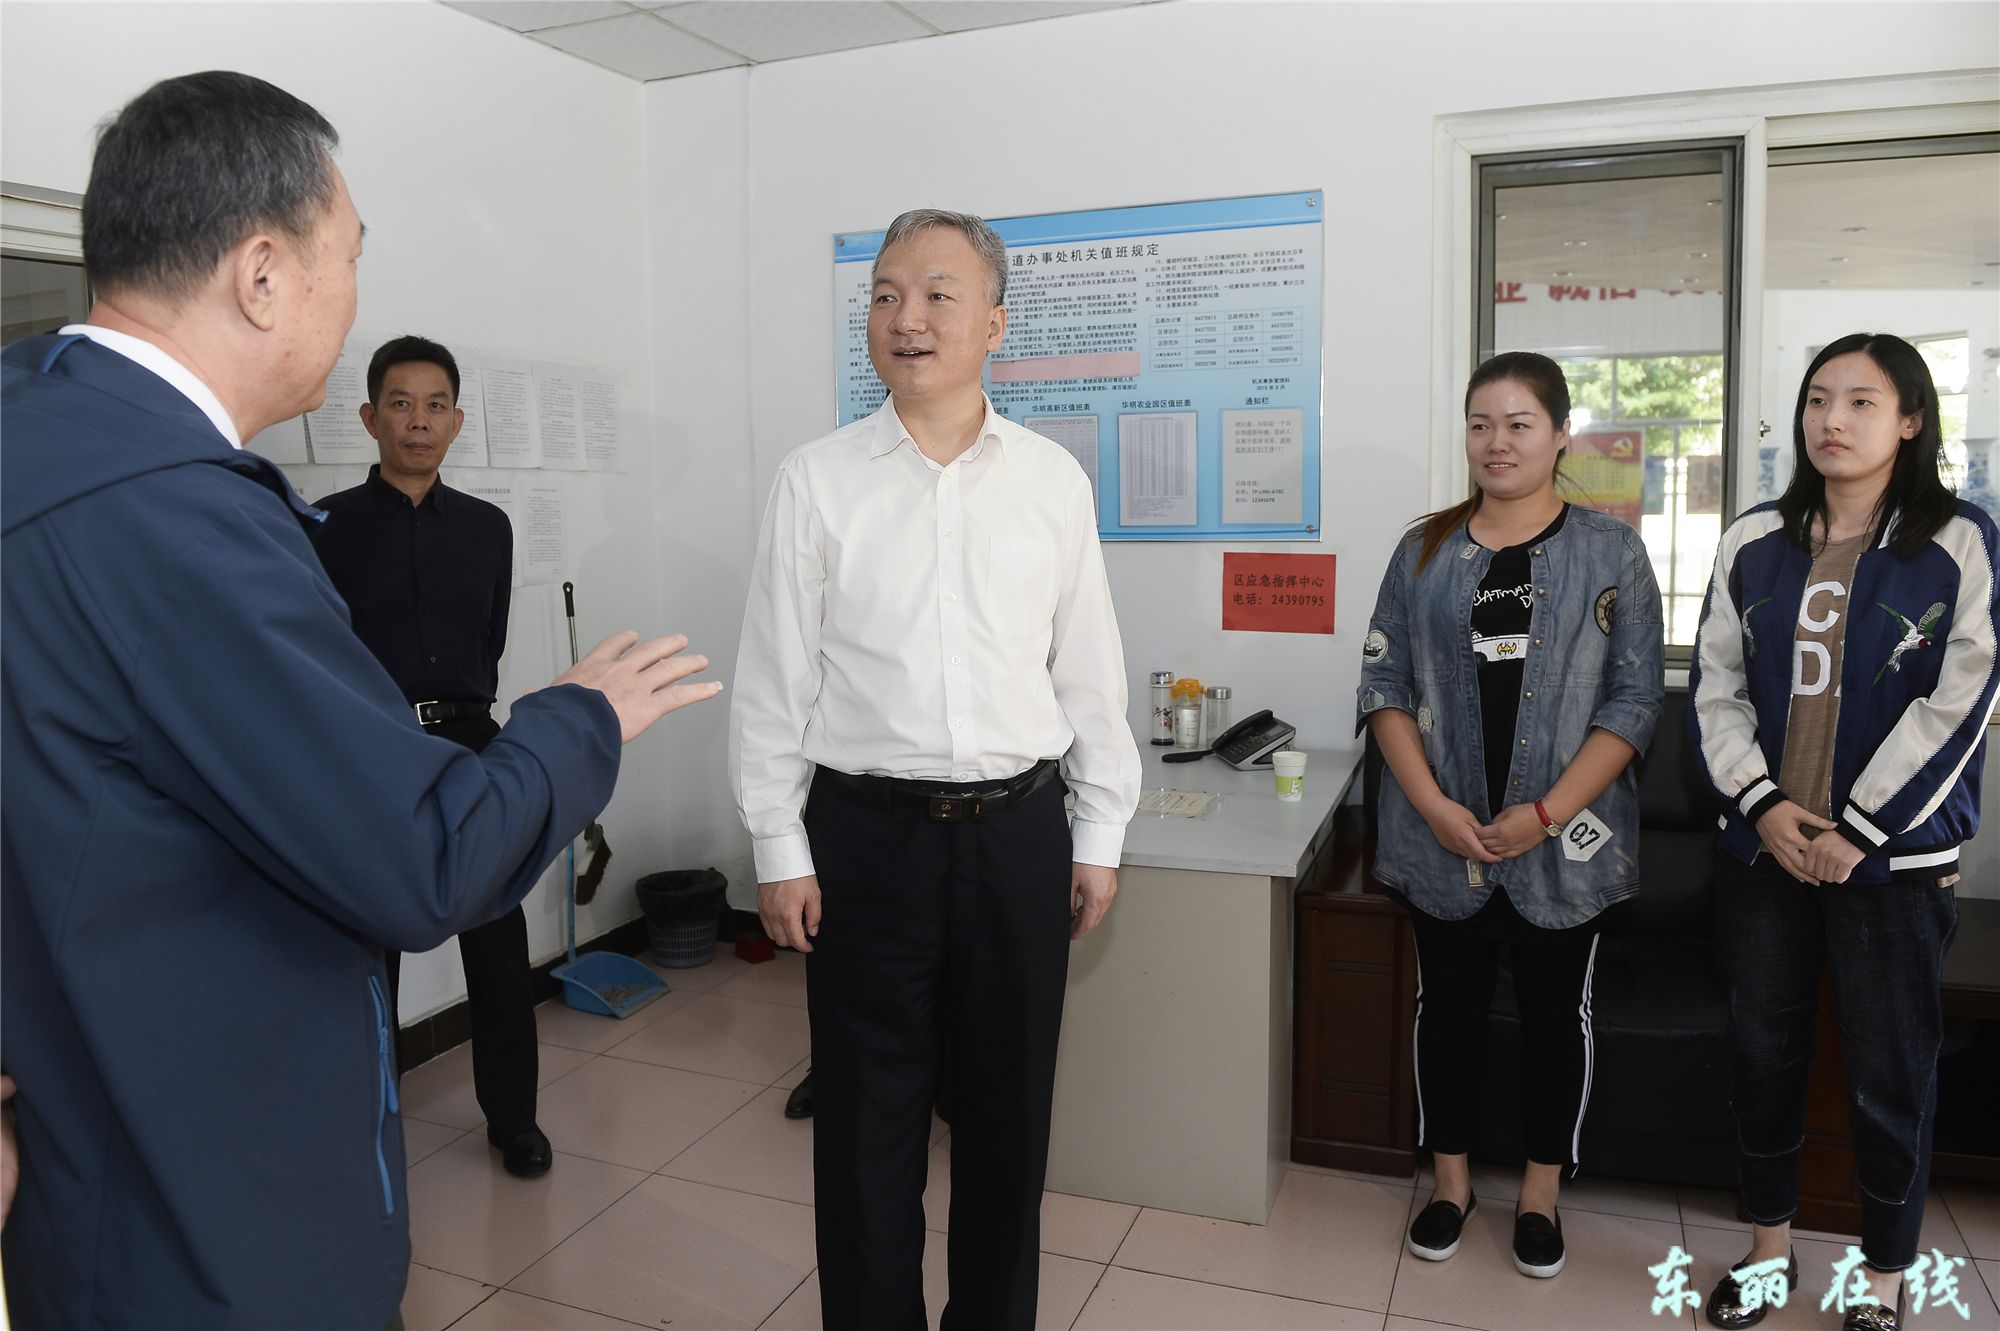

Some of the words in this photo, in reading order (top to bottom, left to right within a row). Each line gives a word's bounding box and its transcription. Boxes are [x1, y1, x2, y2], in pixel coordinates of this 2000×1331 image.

[1008, 243, 1159, 266] 道办事处机关值班规定
[1121, 399, 1192, 409] 华明农业园区值班表
[1245, 397, 1270, 406] 通知栏
[1031, 403, 1091, 413] 华明高新区值班表
[1233, 574, 1325, 589] 区应急指挥中心
[1569, 821, 1601, 851] 07
